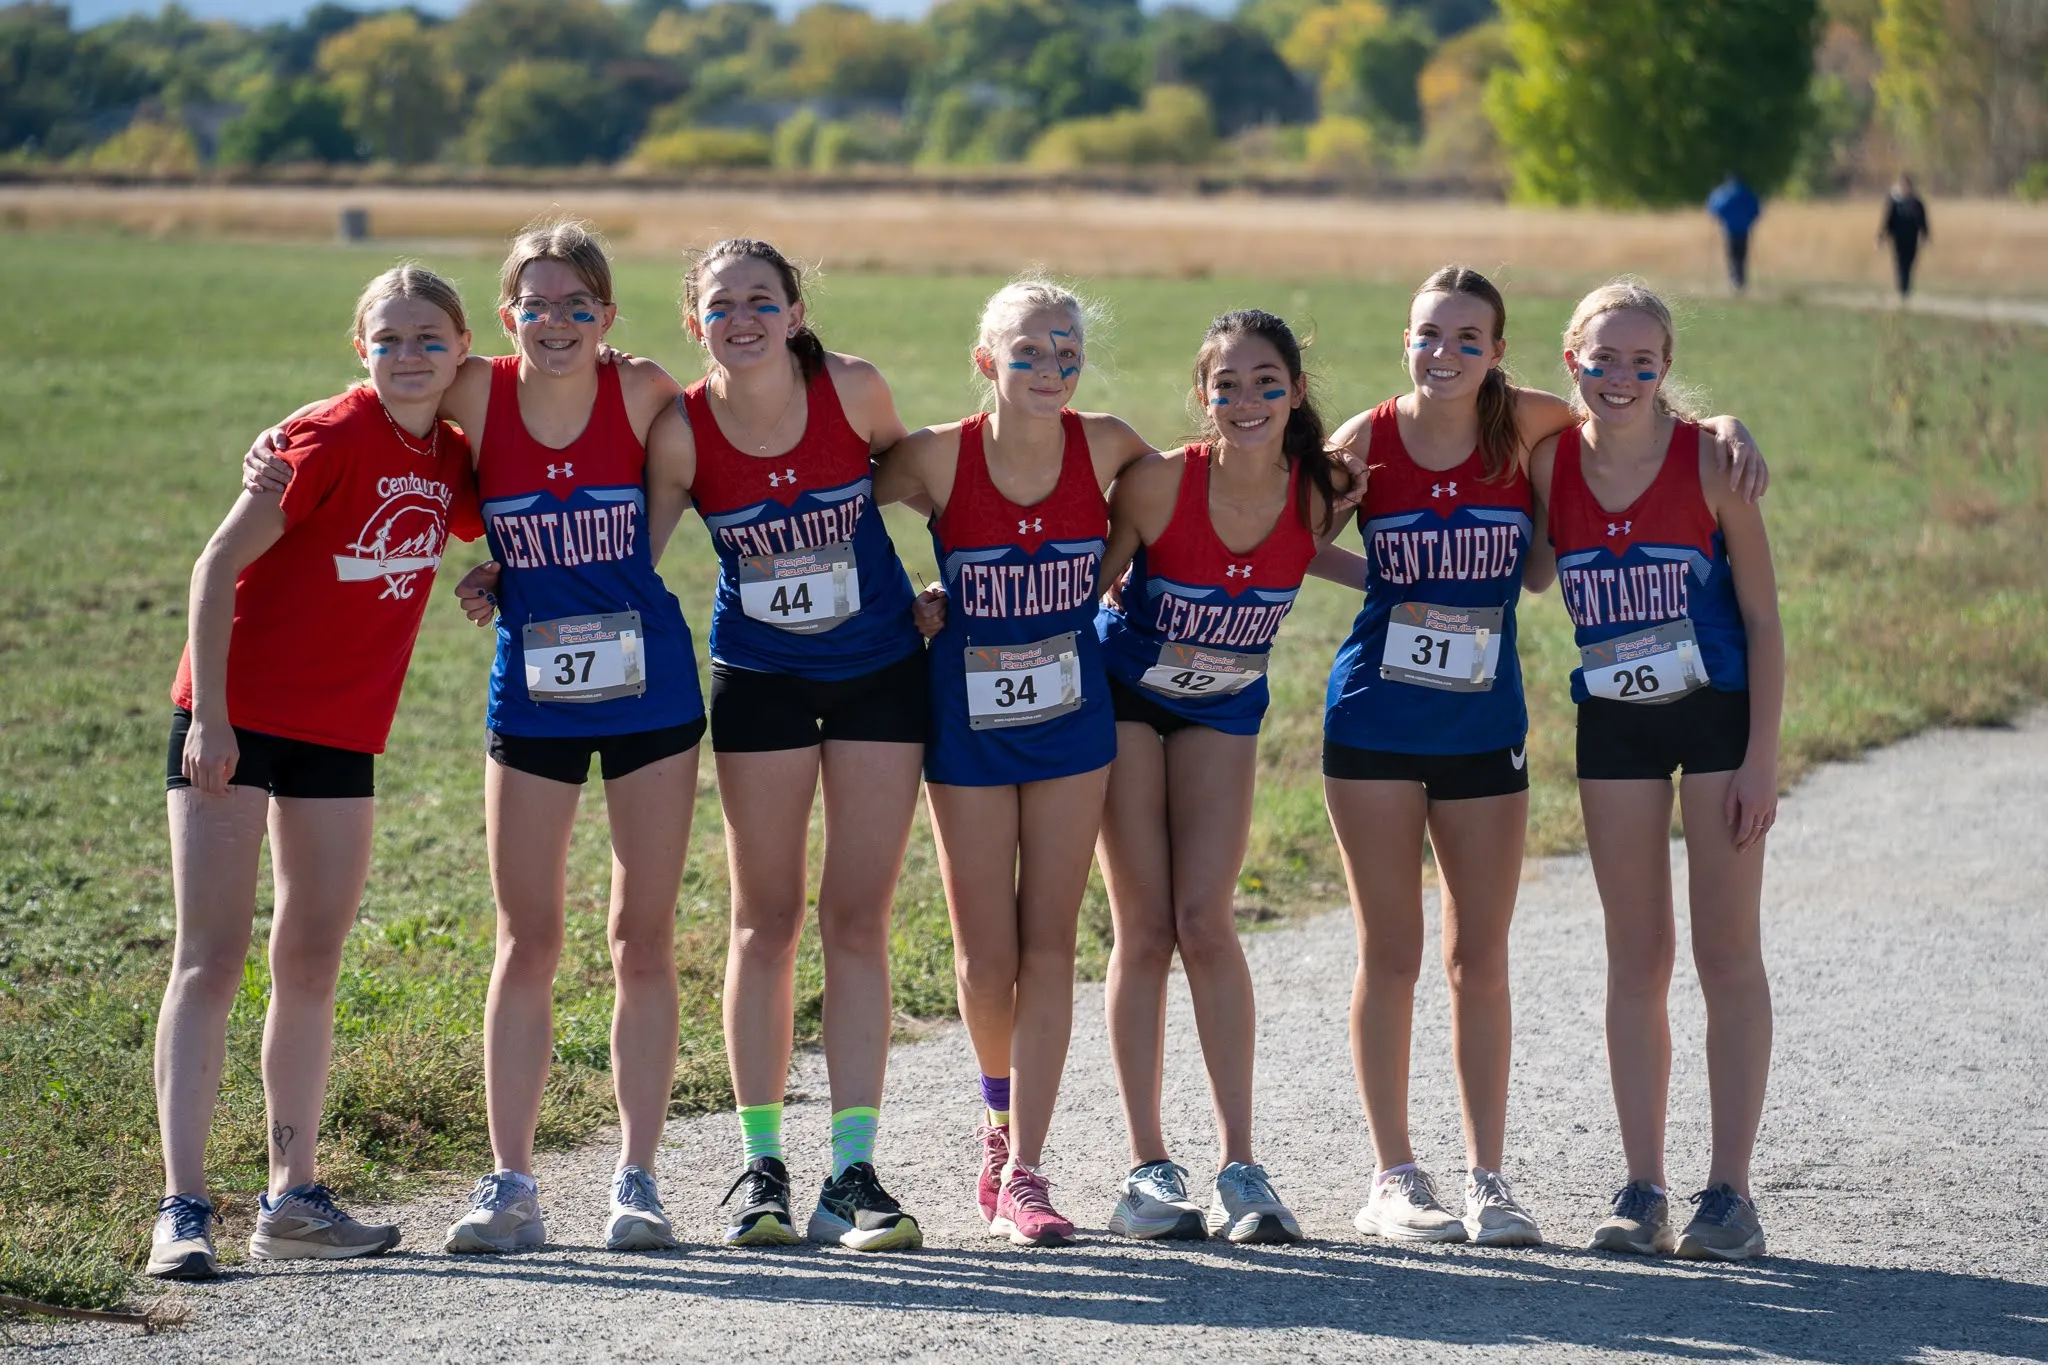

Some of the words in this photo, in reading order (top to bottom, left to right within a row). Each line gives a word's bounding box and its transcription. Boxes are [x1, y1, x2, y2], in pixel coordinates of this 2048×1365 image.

[492, 502, 637, 569] CENTAURUS
[774, 555, 815, 568] Rapid
[1374, 525, 1520, 584] CENTAURUS
[775, 563, 831, 578] Results
[378, 573, 417, 600] XC
[961, 552, 1095, 618] CENTAURUS
[1562, 562, 1689, 626] CENTAURUS
[770, 583, 813, 616] 44
[1155, 591, 1292, 646] CENTAURUS
[1426, 619, 1479, 632] Results
[1427, 609, 1469, 623] Rapid
[559, 621, 601, 634] Rapid
[560, 630, 616, 644] Results
[1411, 635, 1450, 669] 31
[1615, 635, 1656, 652] Rapid
[1616, 642, 1671, 661] Results
[1000, 648, 1041, 661] Rapid
[1001, 655, 1054, 669] Results
[1194, 652, 1236, 665] Rapid
[554, 651, 595, 685] 37
[1192, 660, 1244, 673] Results
[1170, 671, 1216, 691] 42
[1613, 664, 1659, 697] 26
[994, 675, 1037, 707] 34
